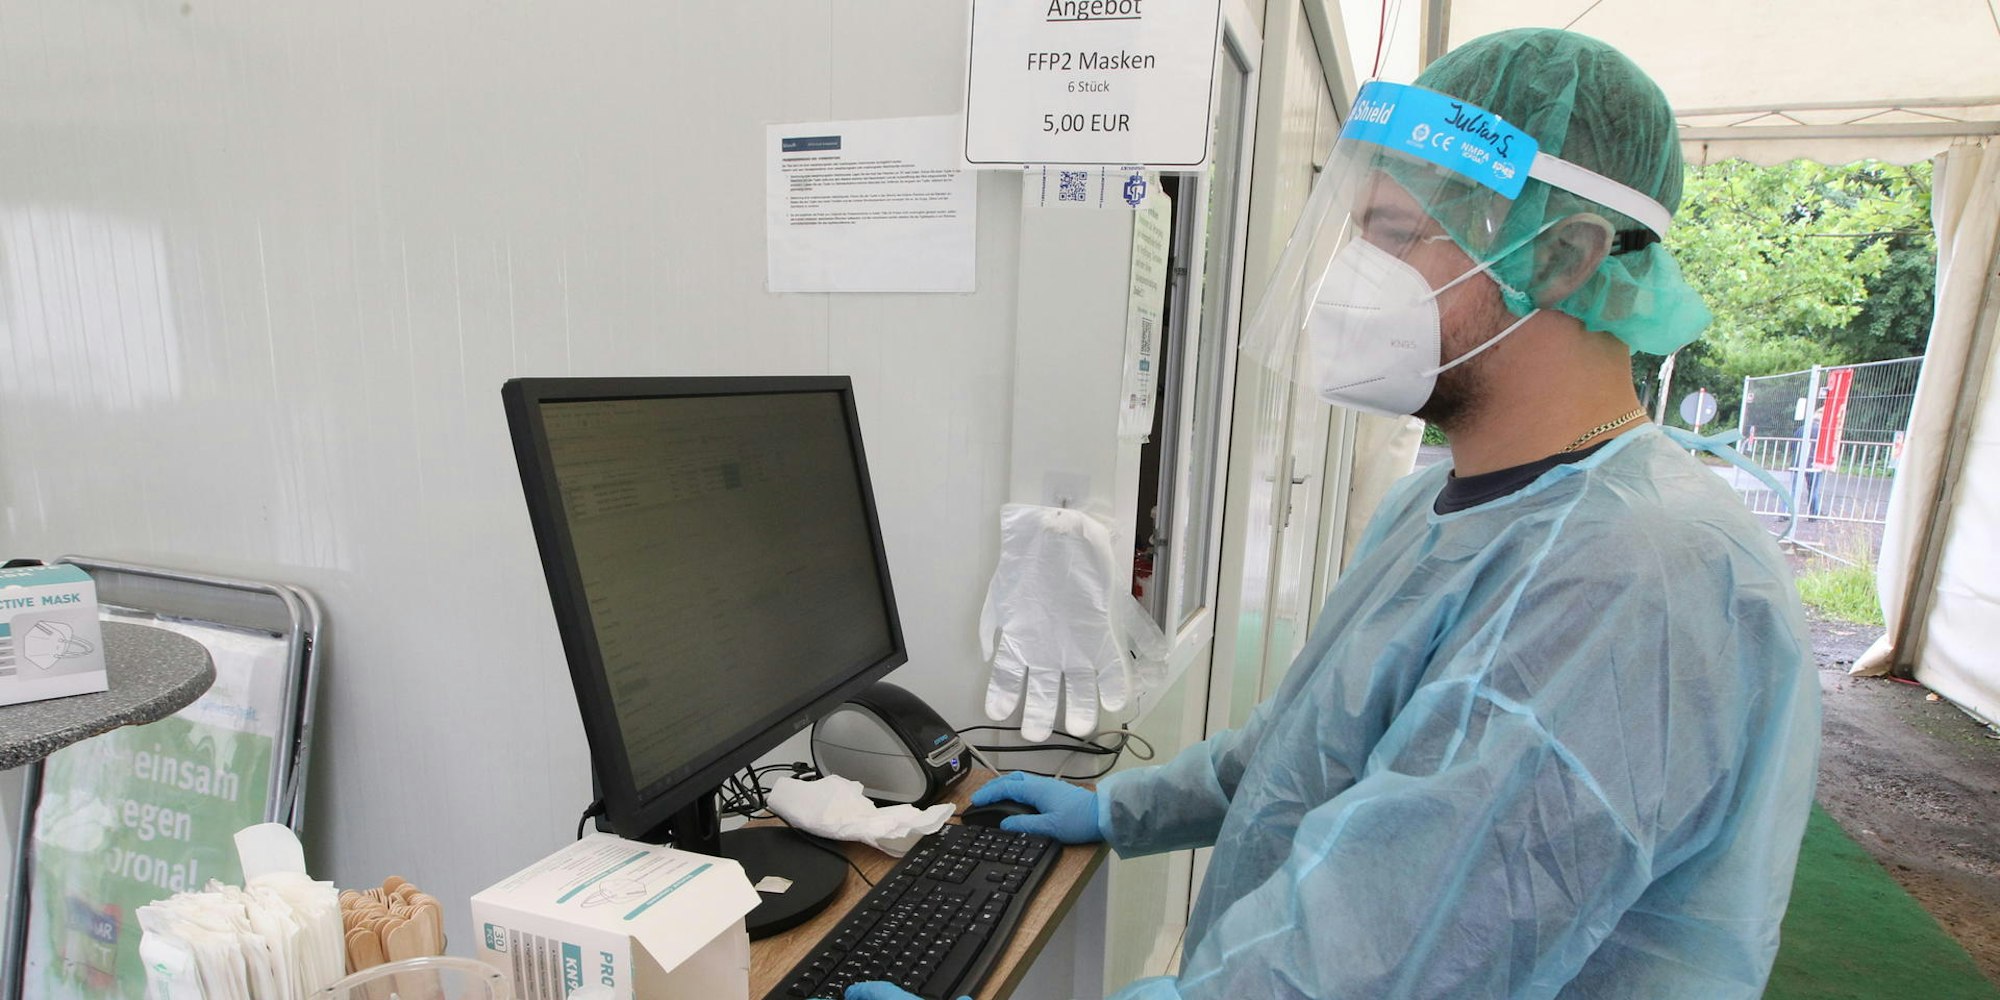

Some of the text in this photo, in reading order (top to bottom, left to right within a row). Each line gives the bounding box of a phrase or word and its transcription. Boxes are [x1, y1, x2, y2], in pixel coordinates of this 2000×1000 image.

[1048, 0, 1141, 18] Angebot
[1028, 50, 1154, 70] FFP2 Masken
[1067, 81, 1110, 92] 6 Stück
[1355, 101, 1395, 125] Shield
[1043, 114, 1130, 134] 5,00 EUR
[41, 593, 81, 605] MASK
[123, 797, 192, 842] egen
[109, 846, 199, 893] orona!
[486, 928, 494, 945] PCS
[494, 930, 504, 947] 30
